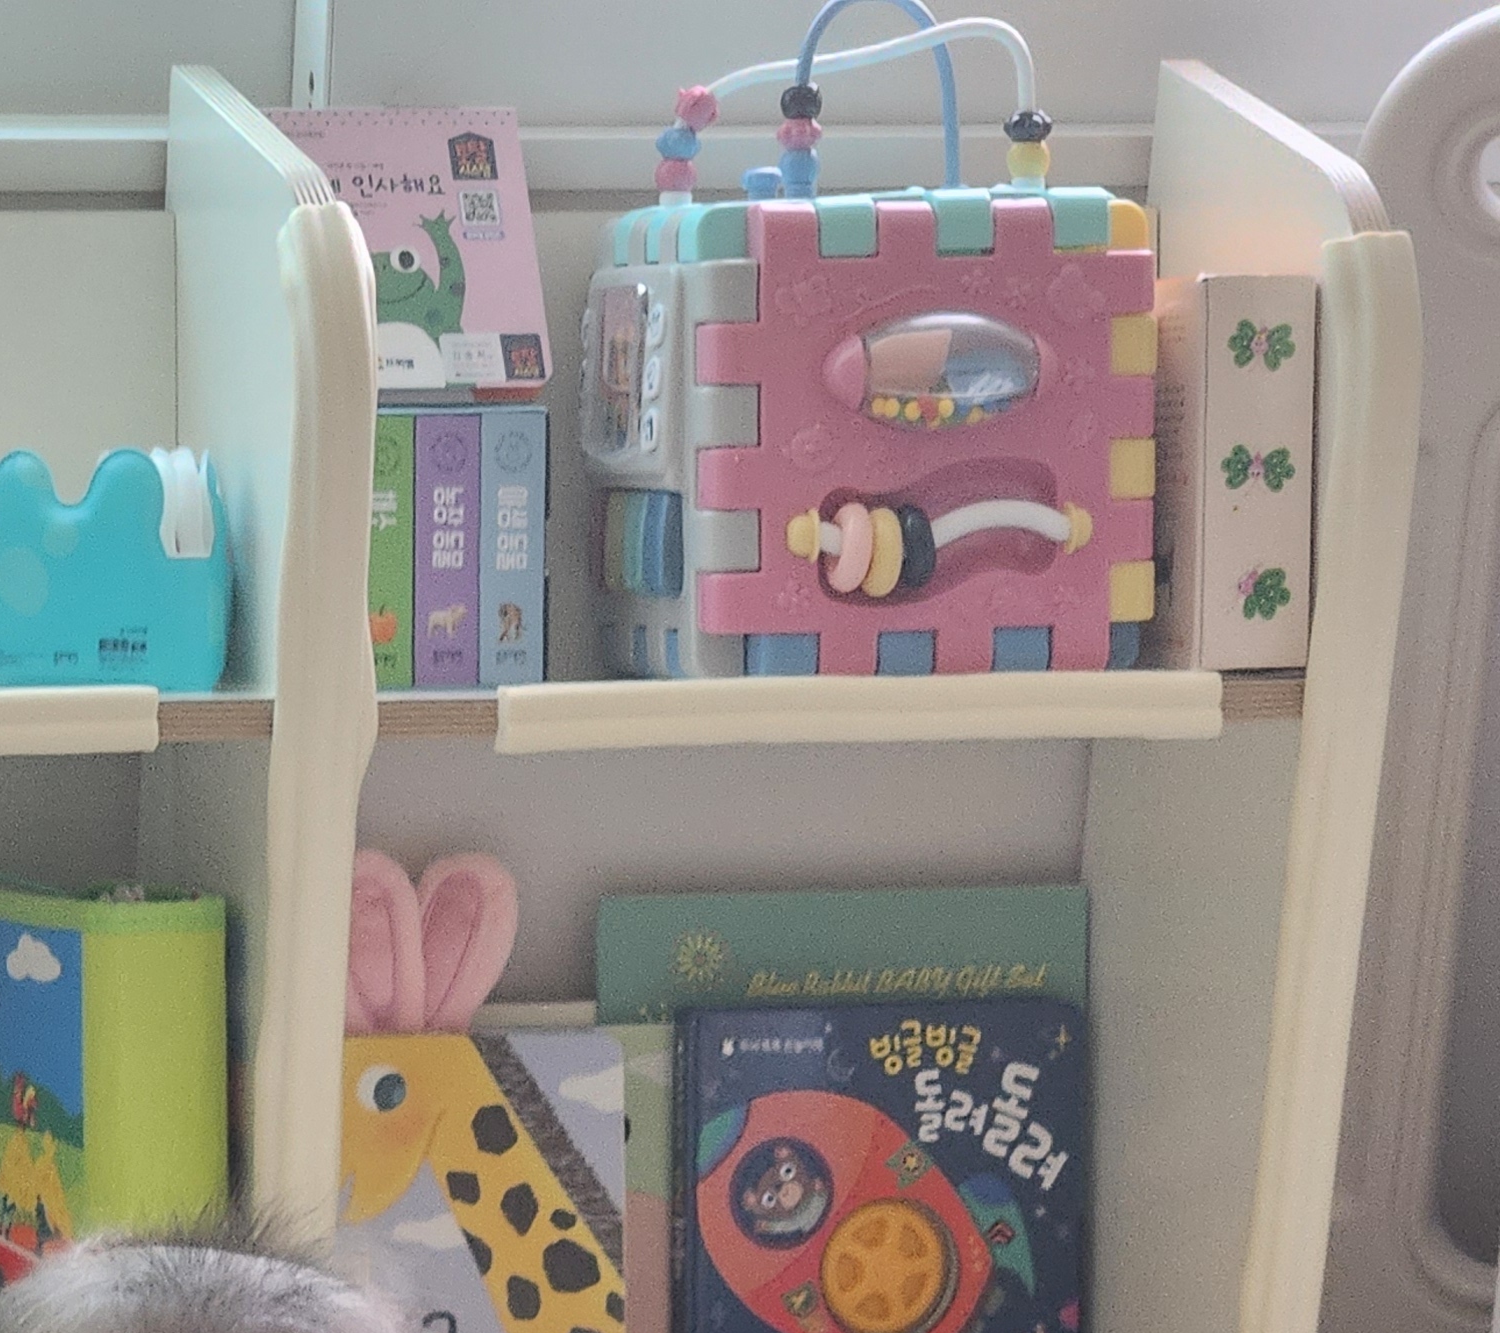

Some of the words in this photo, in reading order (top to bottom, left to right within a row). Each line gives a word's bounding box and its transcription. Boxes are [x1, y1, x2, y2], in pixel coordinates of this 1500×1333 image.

[352, 174, 445, 198] 인사해요
[433, 486, 465, 525] 농장
[432, 530, 464, 570] 동물
[496, 533, 529, 572] 동물
